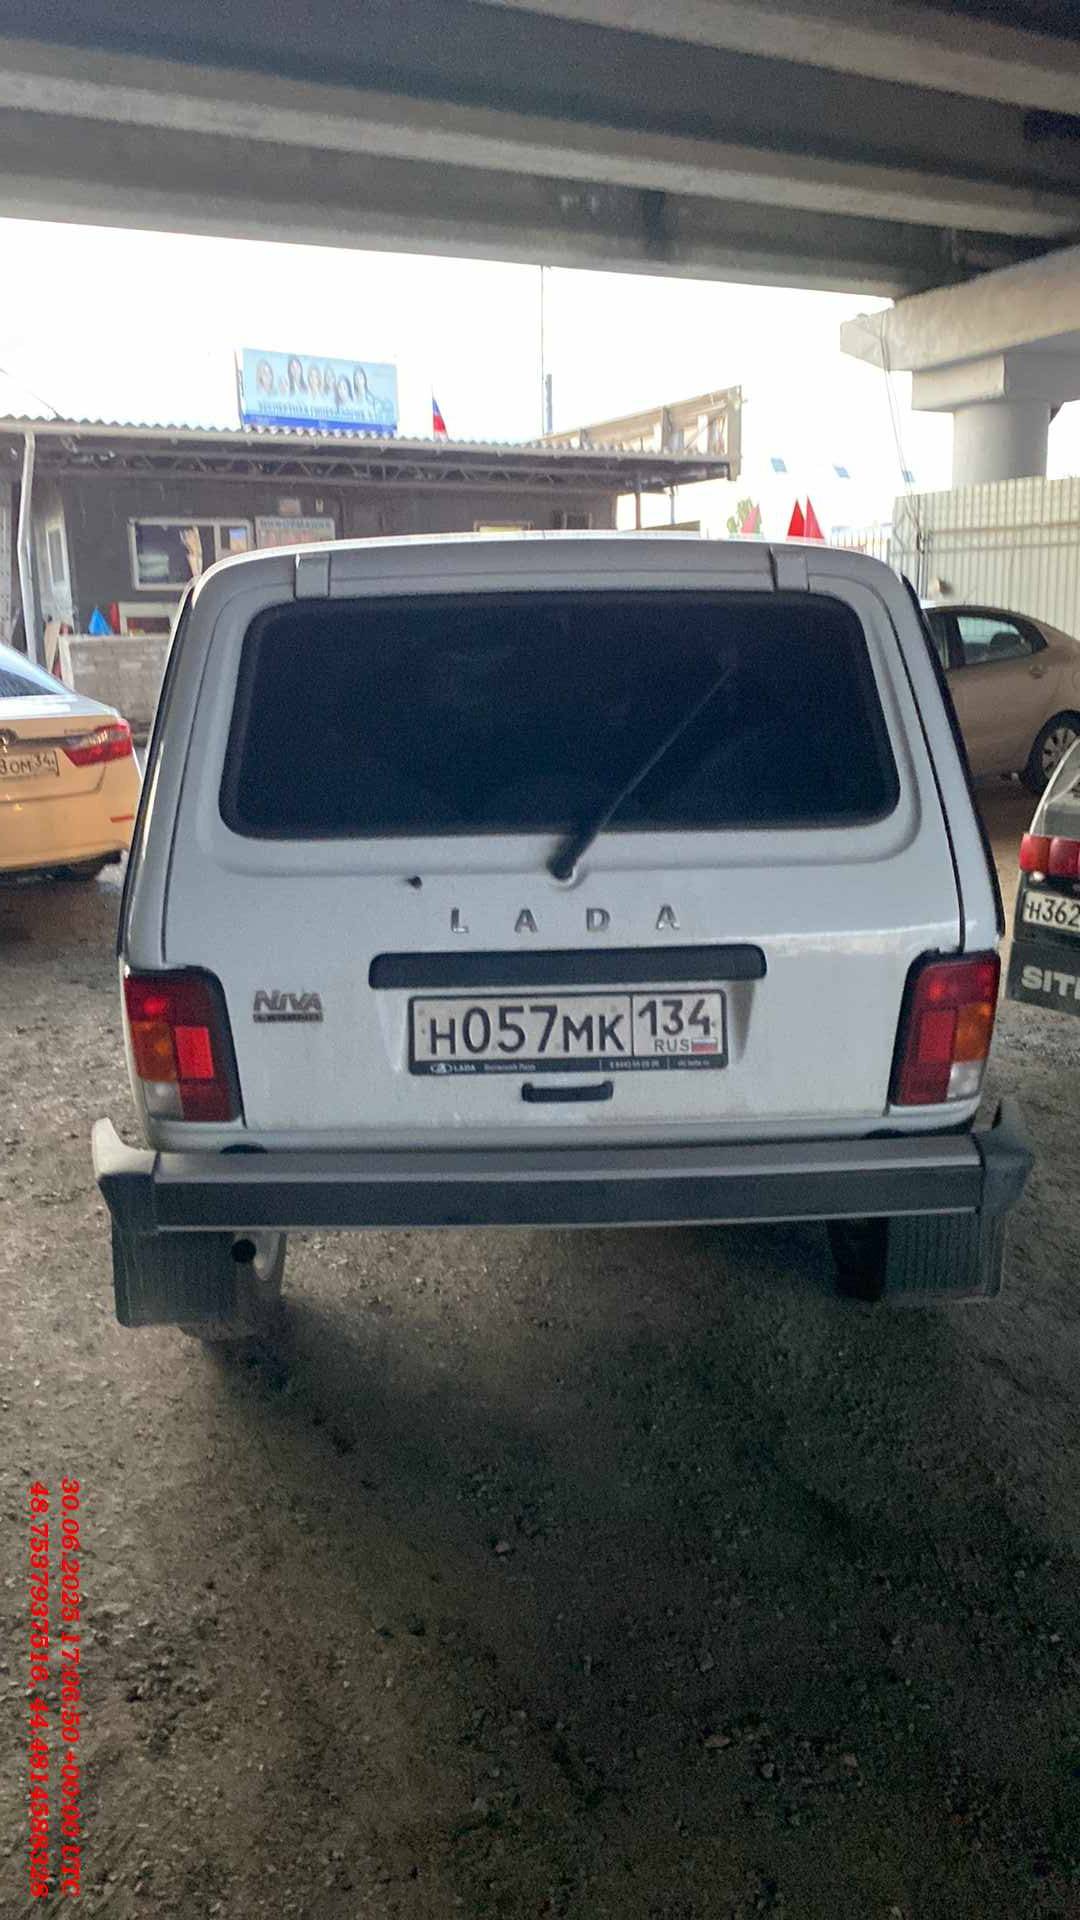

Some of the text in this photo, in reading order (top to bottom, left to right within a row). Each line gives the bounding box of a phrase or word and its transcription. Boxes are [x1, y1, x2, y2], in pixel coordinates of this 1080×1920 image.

[451, 904, 681, 934] LADA
[1021, 964, 1080, 999] SIT
[430, 998, 710, 1054] Н057МК 134
[654, 1038, 689, 1053] RUS
